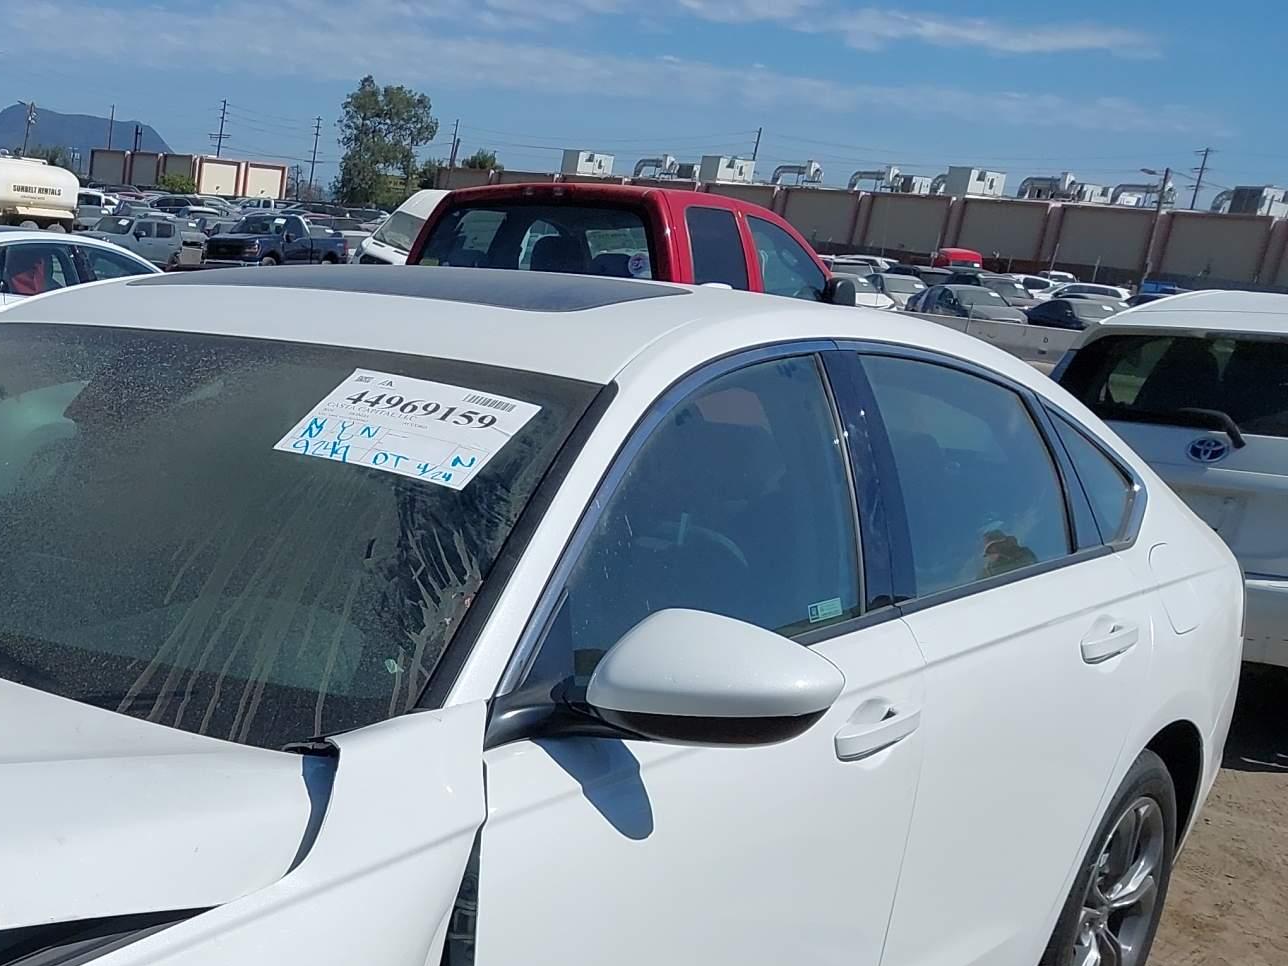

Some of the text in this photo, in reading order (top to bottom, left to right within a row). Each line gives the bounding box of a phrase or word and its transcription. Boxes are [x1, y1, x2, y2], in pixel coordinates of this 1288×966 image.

[13, 184, 62, 196] SUNBELT RENTALS
[346, 390, 497, 430] 44969159
[357, 405, 396, 418] CAPITAL
[396, 413, 417, 422] LLC
[360, 425, 381, 438] N
[451, 455, 476, 468] N
[416, 462, 453, 482] 4/24
